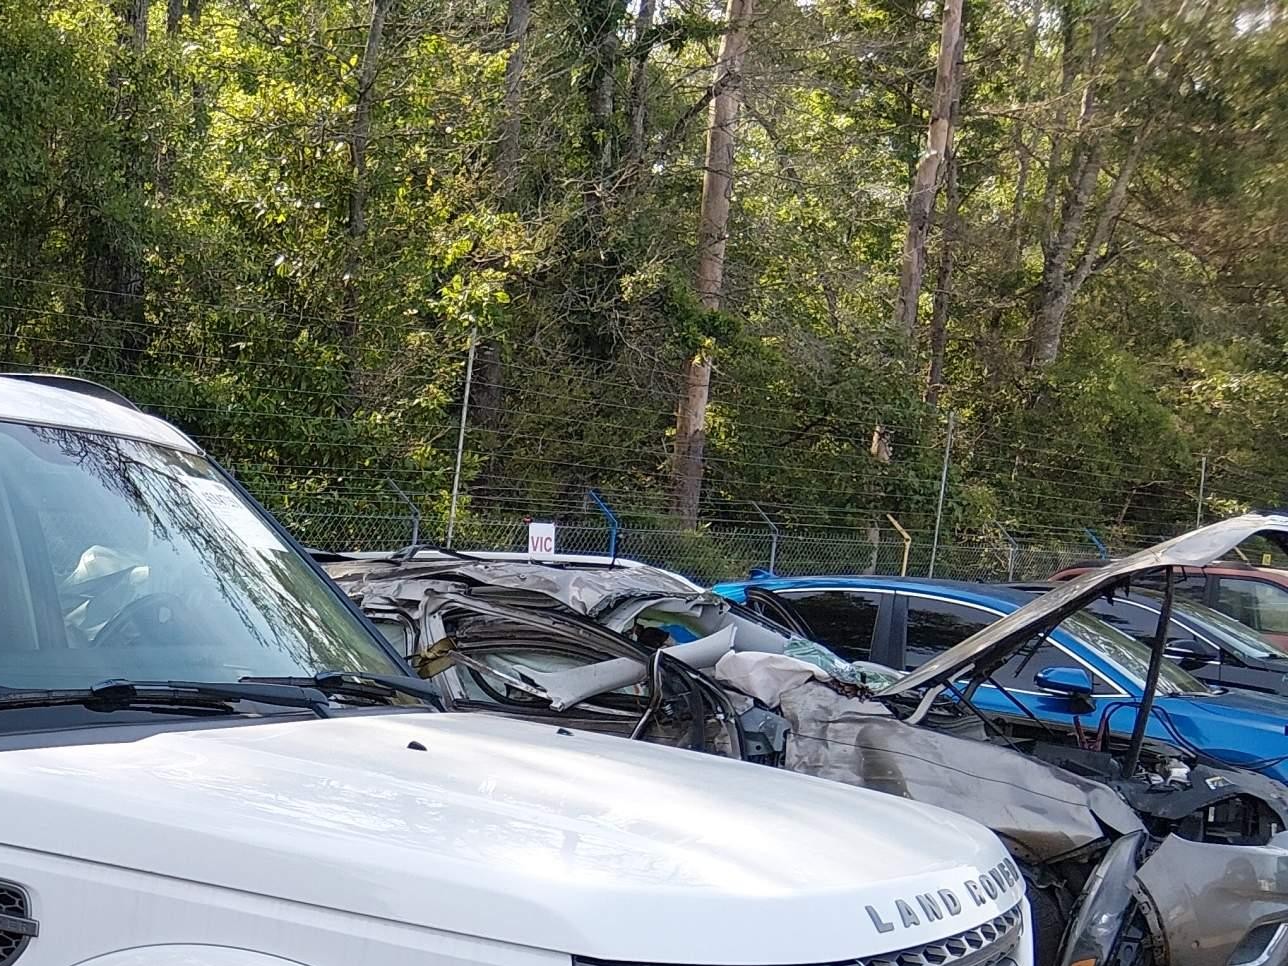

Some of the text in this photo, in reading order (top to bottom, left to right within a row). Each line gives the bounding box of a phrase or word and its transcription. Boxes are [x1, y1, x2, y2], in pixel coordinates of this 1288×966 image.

[530, 535, 553, 553] VIC
[864, 857, 1020, 934] LAND ROVER
